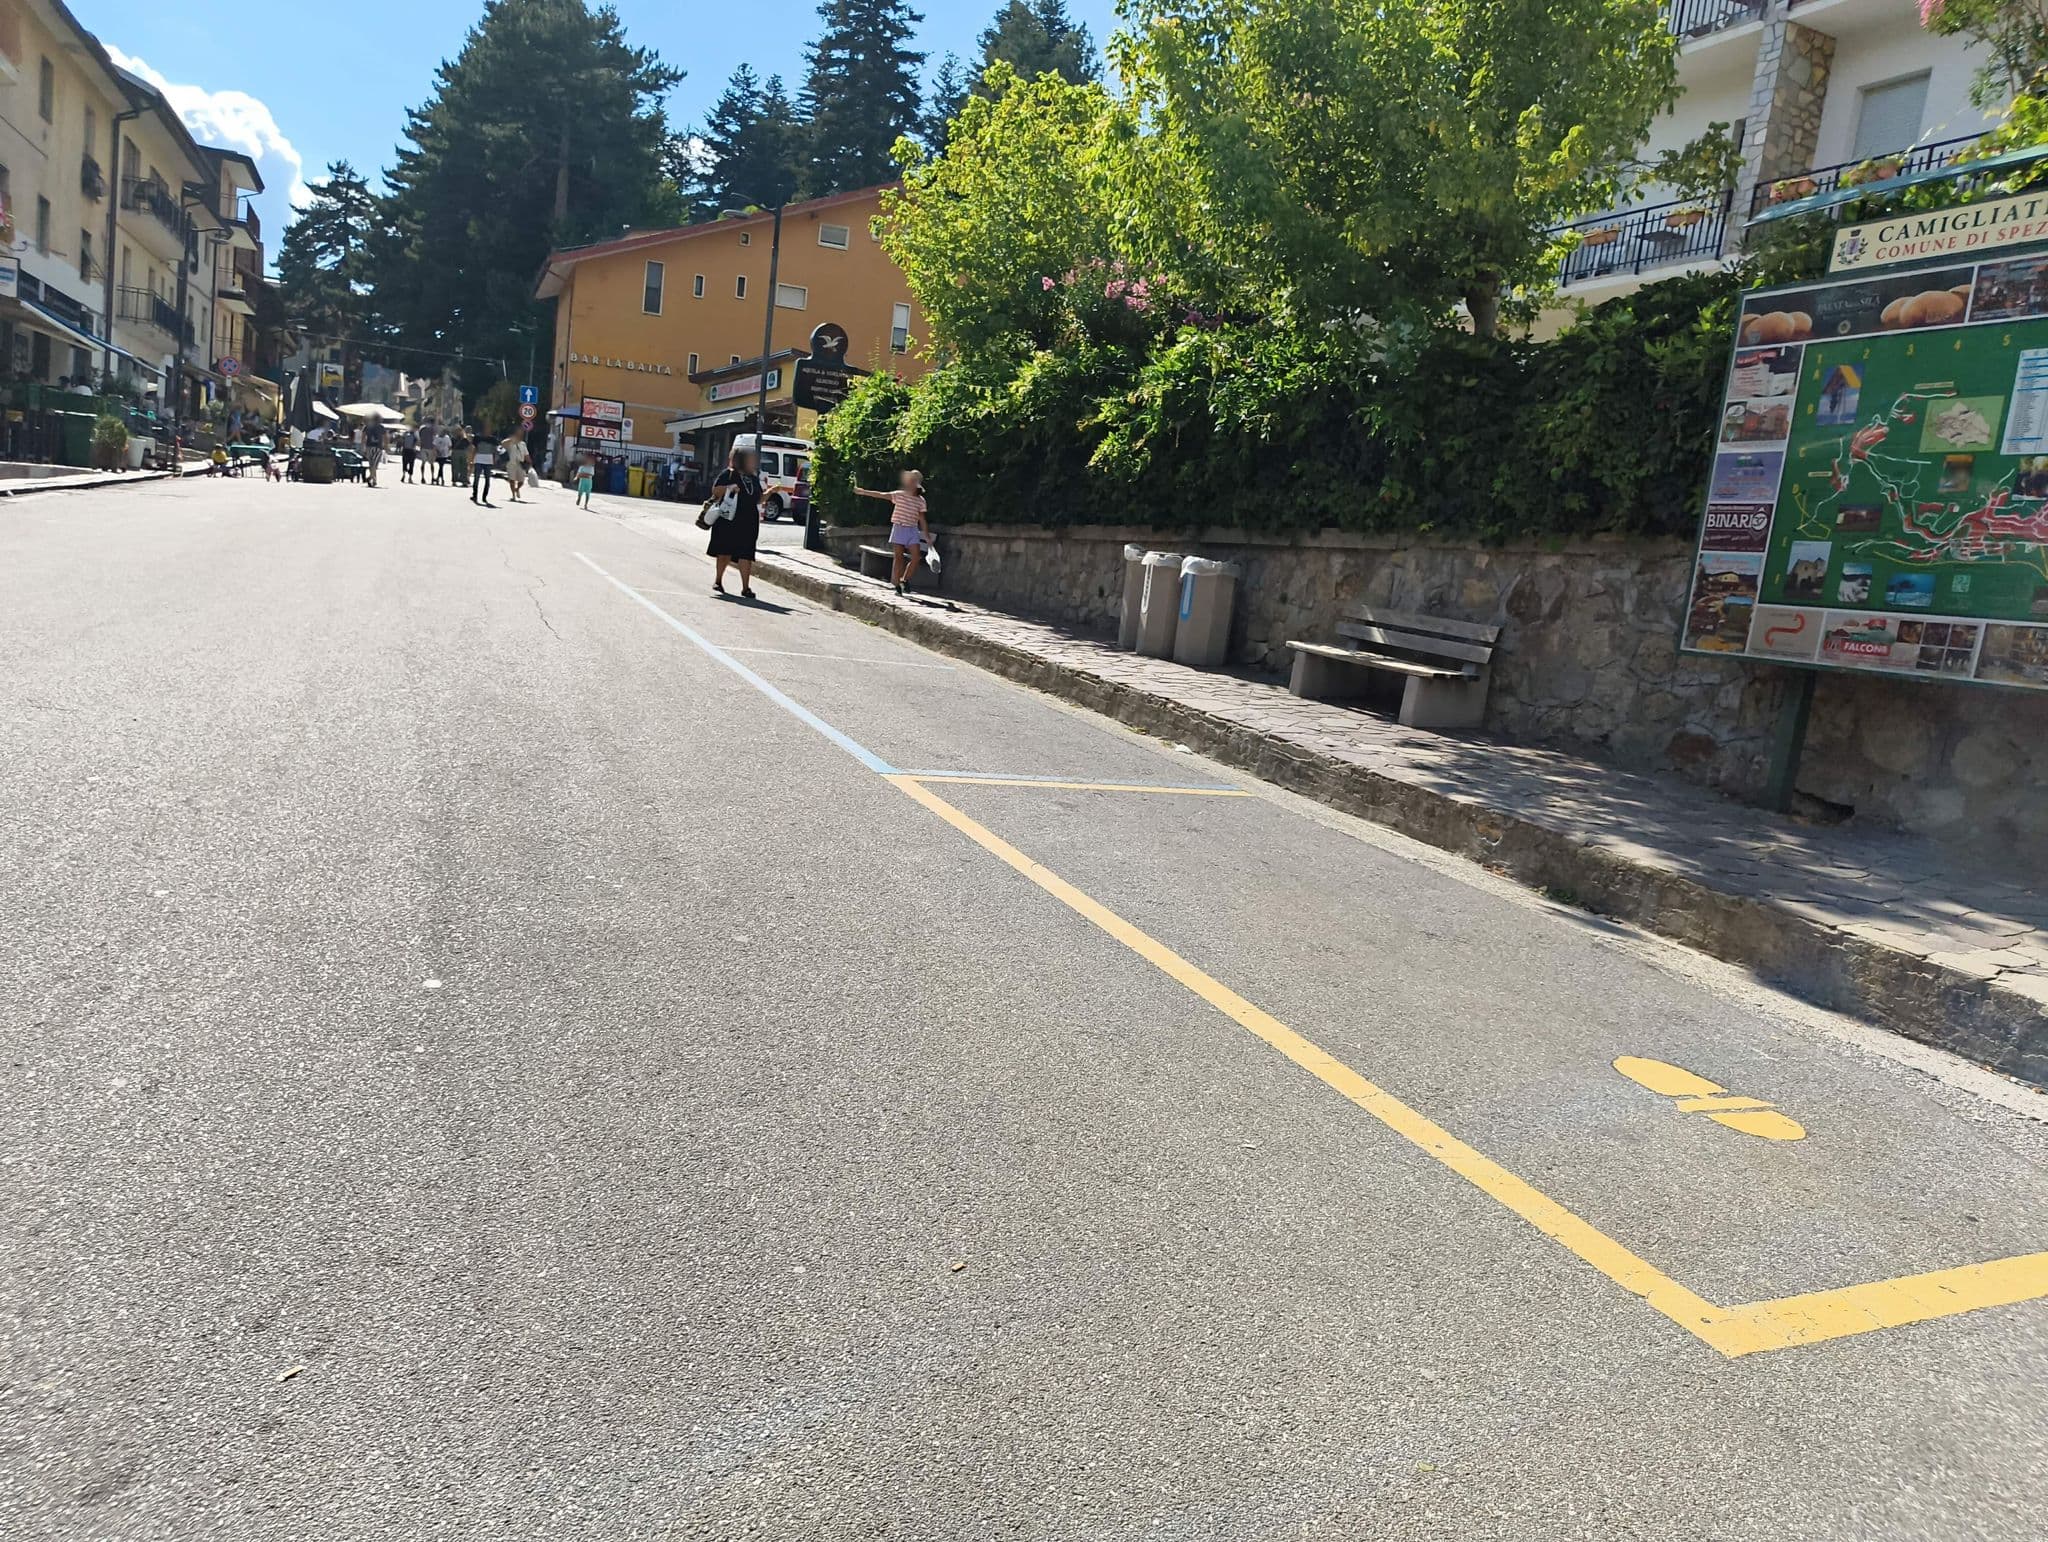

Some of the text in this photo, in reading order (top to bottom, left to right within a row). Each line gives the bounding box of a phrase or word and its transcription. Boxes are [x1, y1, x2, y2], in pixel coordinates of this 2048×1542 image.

[1875, 221, 2048, 260] COMUNE DI SPEZ
[570, 352, 672, 376] BAR LA BAITA
[523, 407, 533, 416] 20
[585, 426, 617, 440] BAR
